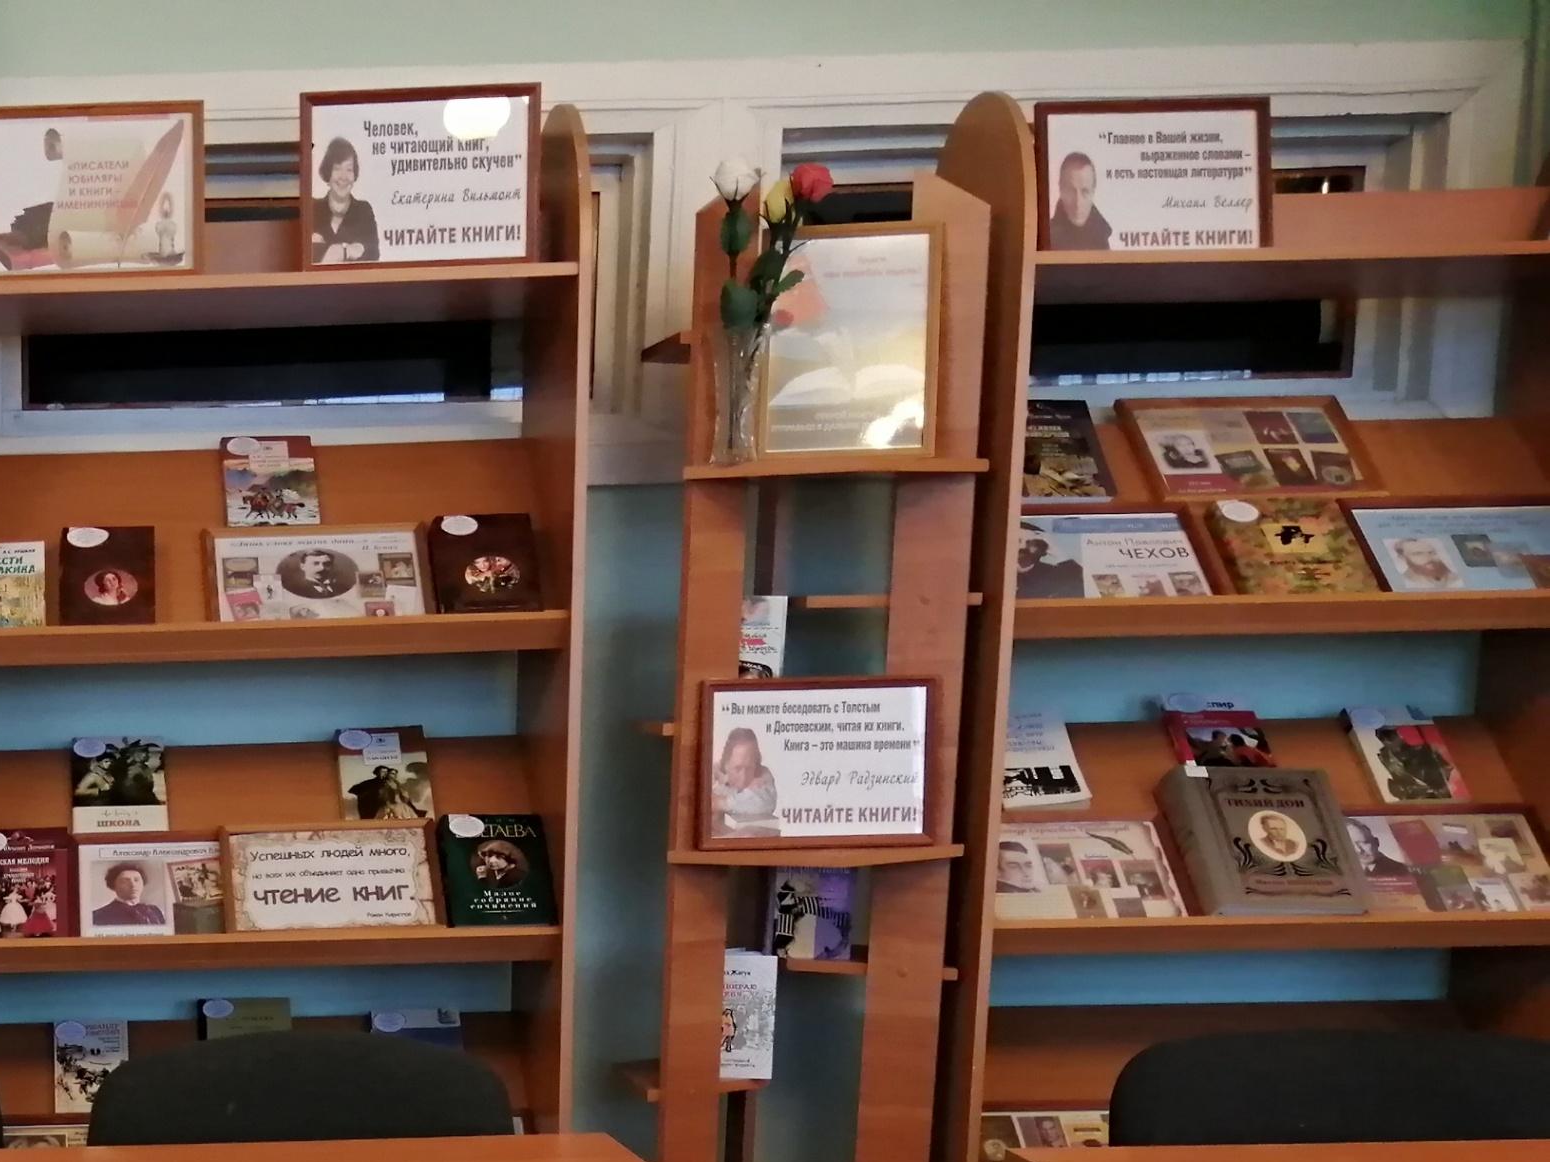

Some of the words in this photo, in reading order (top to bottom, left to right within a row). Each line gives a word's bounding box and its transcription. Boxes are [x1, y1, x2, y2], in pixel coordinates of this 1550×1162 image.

[363, 120, 419, 138] Человек,
[1148, 134, 1154, 144] в
[1156, 130, 1187, 145] Вашей
[372, 141, 386, 155] не
[390, 137, 454, 155] читающий
[457, 138, 490, 154] книг,
[1140, 150, 1200, 164] выраженное
[1202, 149, 1243, 161] словами
[391, 156, 468, 176] удивительно
[68, 174, 123, 183] ЮБИЛЯРЫ
[1106, 169, 1112, 179] и
[1114, 168, 1135, 179] есть
[1137, 168, 1188, 181] настоящая
[68, 187, 76, 196] И
[79, 187, 113, 197] КНИГИ
[391, 190, 455, 209] Екатерина
[1162, 196, 1206, 210] Михаил
[1214, 196, 1253, 213] Веллер
[384, 225, 457, 246] ЧИТАЙТЕ
[462, 223, 521, 243] КНИГИ!
[1119, 228, 1190, 247] ЧИТАЙТЕ
[1195, 229, 1253, 246] КНИГИ!
[1118, 547, 1190, 559] ЧЕХОВ
[747, 703, 780, 715] можете
[782, 701, 832, 715] беседовать
[841, 701, 880, 714] Толстым
[766, 723, 772, 733] и
[836, 721, 862, 732] читая
[864, 723, 874, 732] их
[784, 739, 810, 752] Книга
[819, 740, 834, 752] это
[836, 740, 872, 751] машина
[801, 770, 842, 792] Эдвард
[849, 769, 919, 791] Радзинский
[781, 805, 853, 824] ЧИТАЙТЕ
[858, 806, 917, 823] КНИГИ!
[97, 819, 141, 828] ШКОЛА
[250, 850, 315, 863] Успешных
[321, 845, 364, 858] людей
[368, 847, 411, 858] много,
[299, 869, 343, 878] объединяет
[253, 886, 341, 906] чтение
[352, 884, 416, 902] книг.
